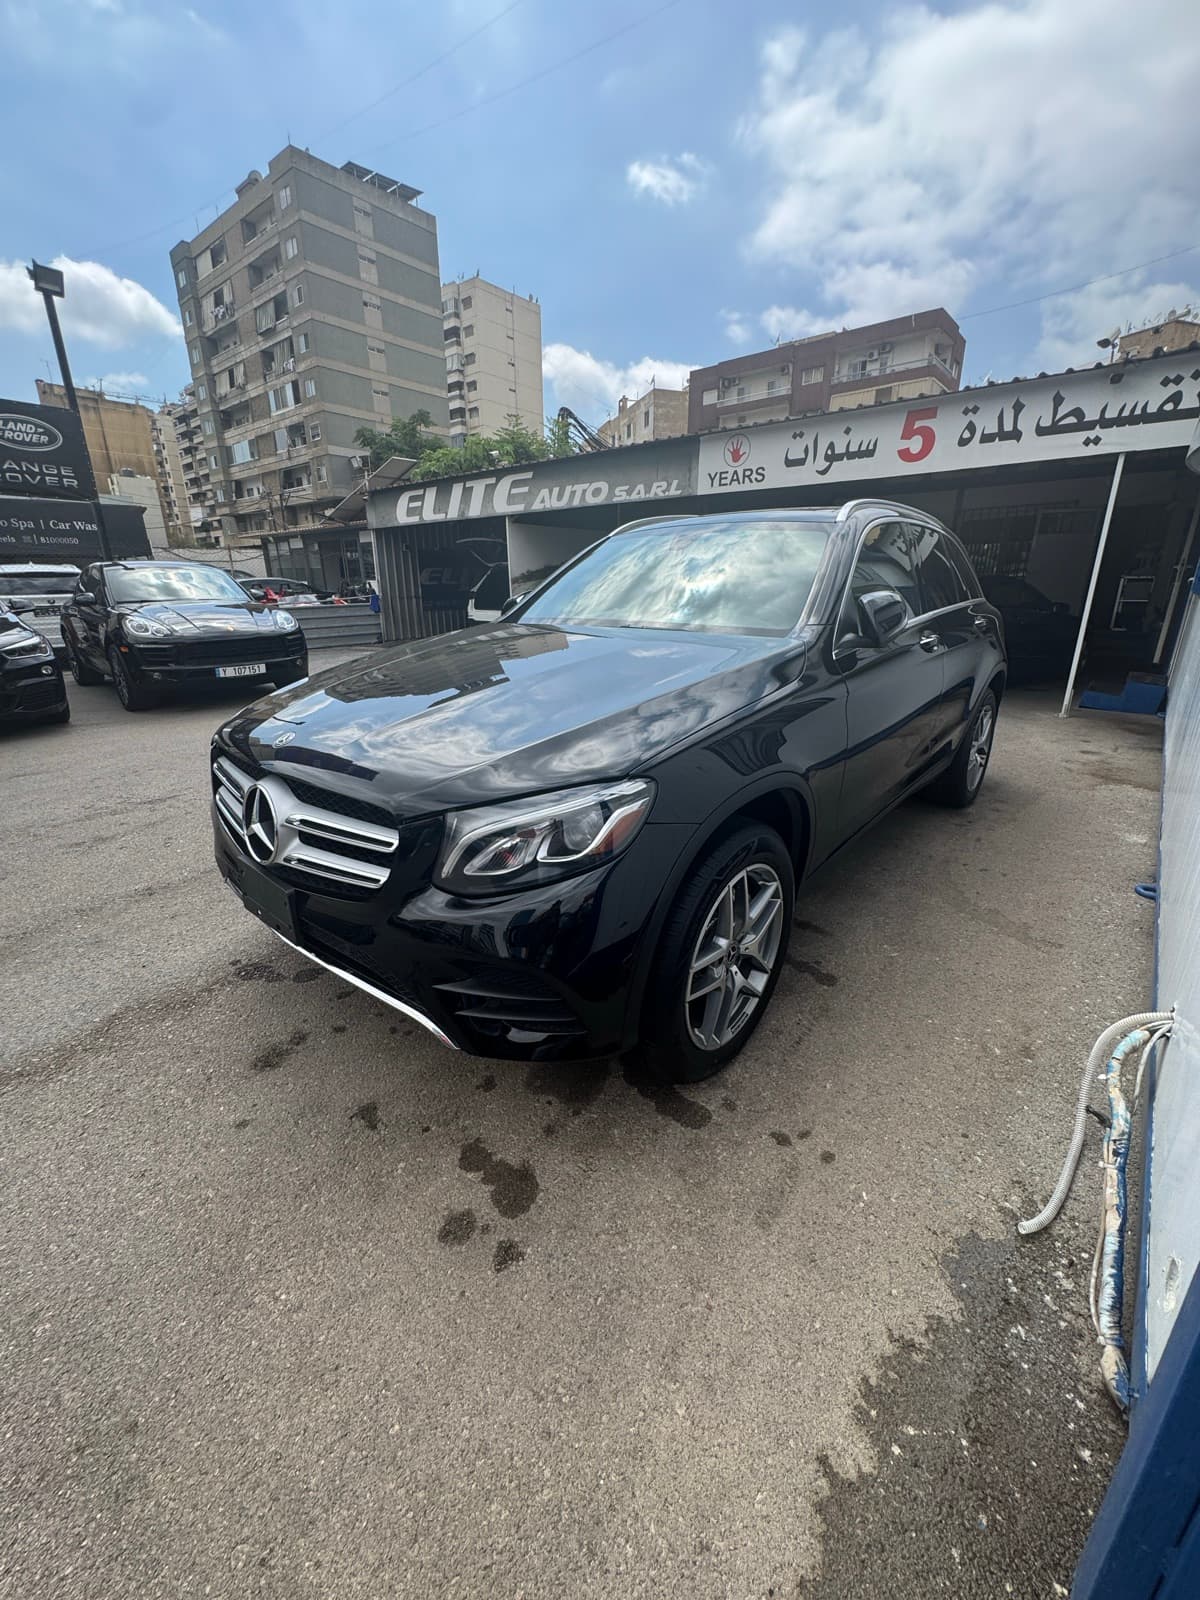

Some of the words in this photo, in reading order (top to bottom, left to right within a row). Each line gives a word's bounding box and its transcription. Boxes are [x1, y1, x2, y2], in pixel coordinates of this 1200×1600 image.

[0, 419, 36, 433] LAND
[957, 395, 1025, 447] لمدة
[4, 430, 49, 444] ROVER
[896, 406, 939, 463] 5
[784, 426, 878, 476] سنوات
[2, 459, 75, 476] ANGE
[0, 472, 79, 488] OVER
[707, 466, 766, 489] YEARS
[395, 471, 534, 524] ELITE
[530, 480, 609, 510] AUTO
[11, 518, 35, 531] Spa
[49, 519, 72, 530] Car
[73, 520, 98, 532] Was
[222, 668, 227, 677] Y
[232, 664, 261, 676] 107151
